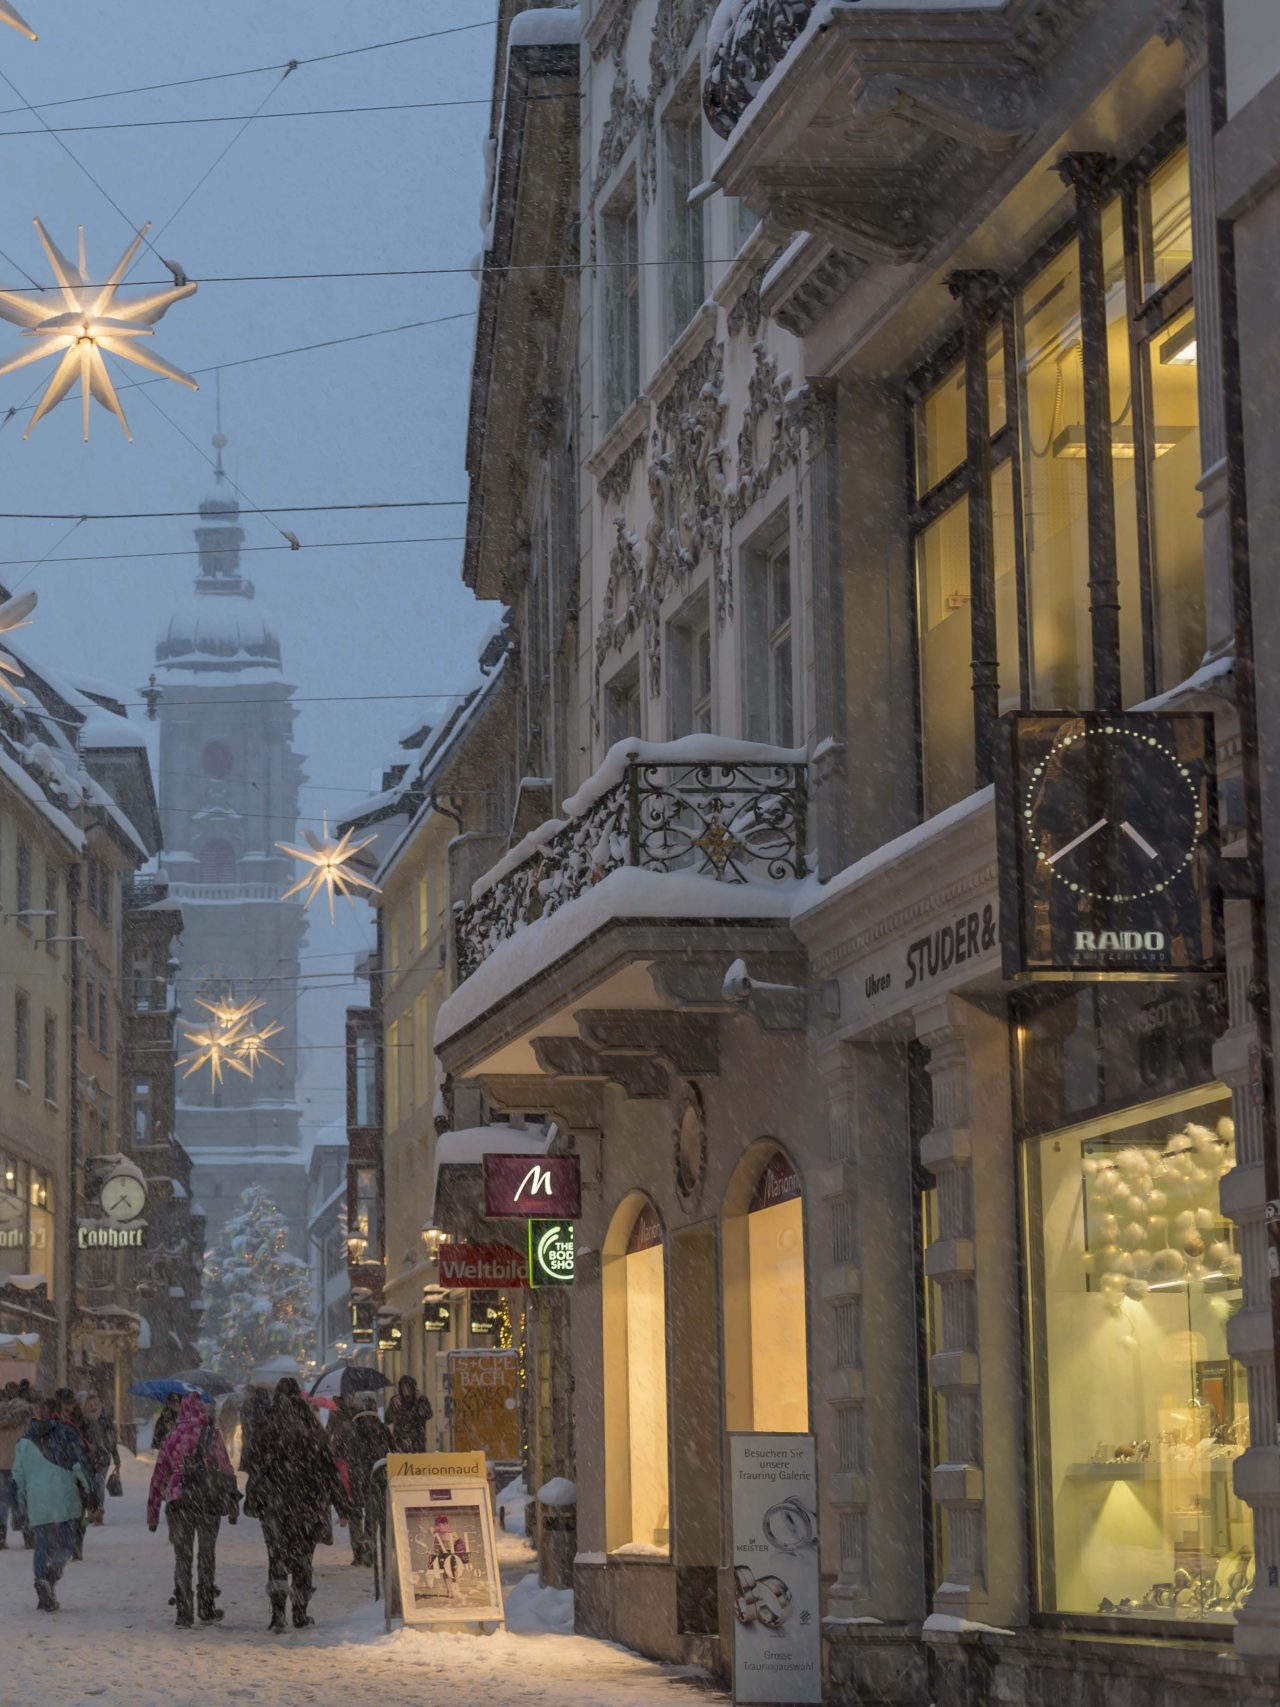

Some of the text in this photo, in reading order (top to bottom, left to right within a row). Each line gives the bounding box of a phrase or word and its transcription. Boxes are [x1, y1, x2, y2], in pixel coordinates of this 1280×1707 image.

[1074, 930, 1165, 951] RADO
[865, 973, 891, 998] Uhren
[905, 912, 980, 990] STUDER
[554, 1242, 574, 1251] THE
[460, 1371, 505, 1386] BACH
[744, 1448, 804, 1459] Besuchen Sie
[397, 1461, 480, 1477] Marionnaud
[760, 1460, 790, 1470] unsere
[738, 1470, 811, 1483] Trauring Galerie
[414, 1531, 479, 1555] SALE
[736, 1544, 769, 1552] MEISTER
[763, 1650, 793, 1661] Grosse
[743, 1661, 815, 1674] Trauringauswahl
